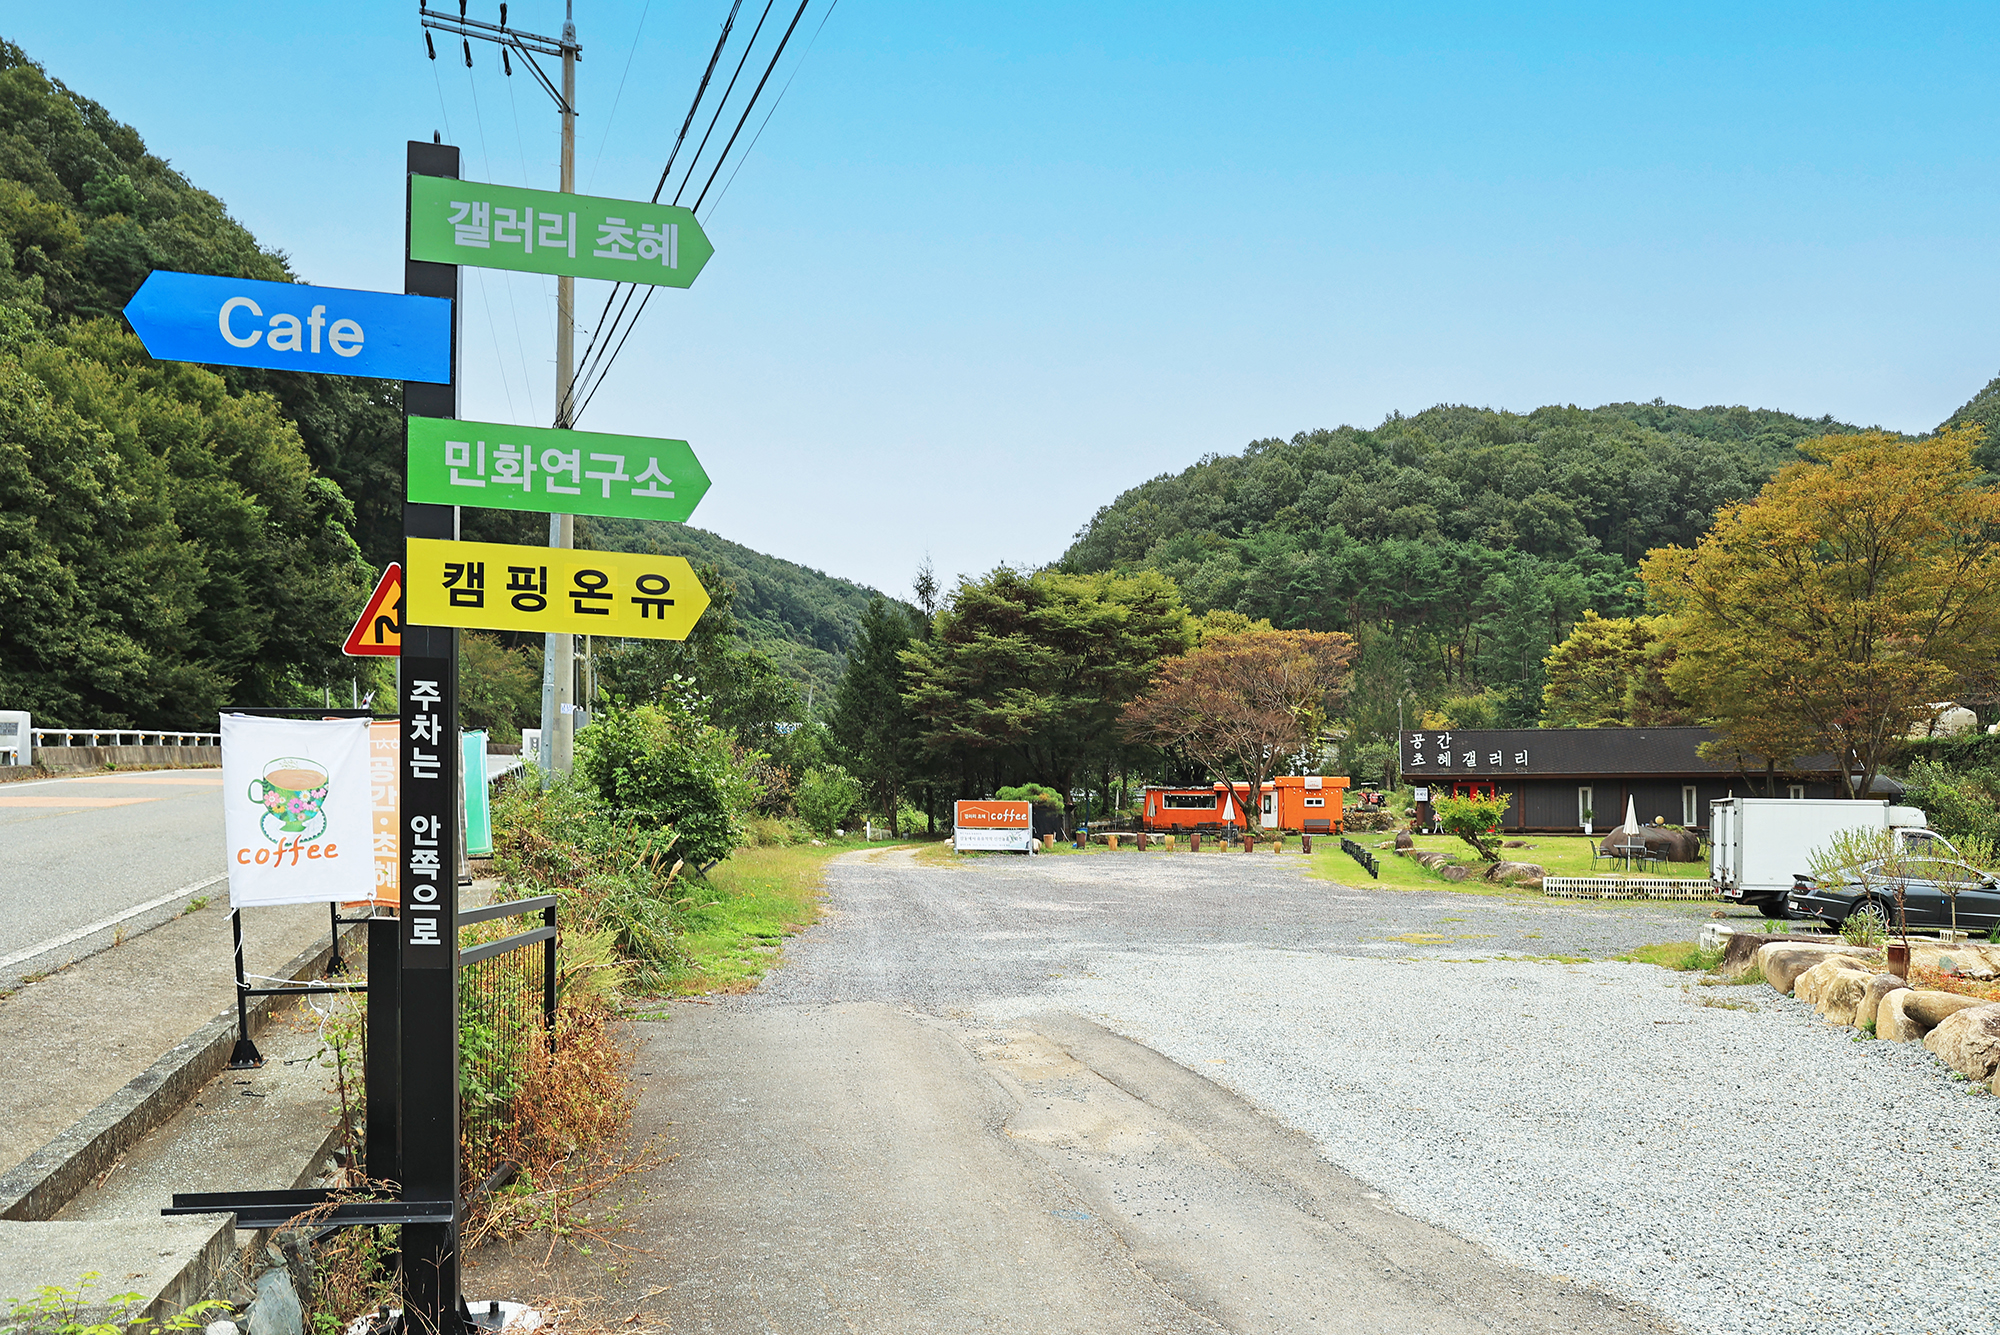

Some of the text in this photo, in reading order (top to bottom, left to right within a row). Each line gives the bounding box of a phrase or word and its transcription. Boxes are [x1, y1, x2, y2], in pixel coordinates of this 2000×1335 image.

[447, 200, 679, 269] 갤러리 초혜
[218, 296, 365, 357] Cafe
[444, 440, 676, 499] 민화연구소
[1409, 731, 1453, 750] 공간
[409, 679, 442, 946] 주차는 안쪽으로
[990, 808, 1027, 822] coffee
[237, 835, 339, 868] coffee
